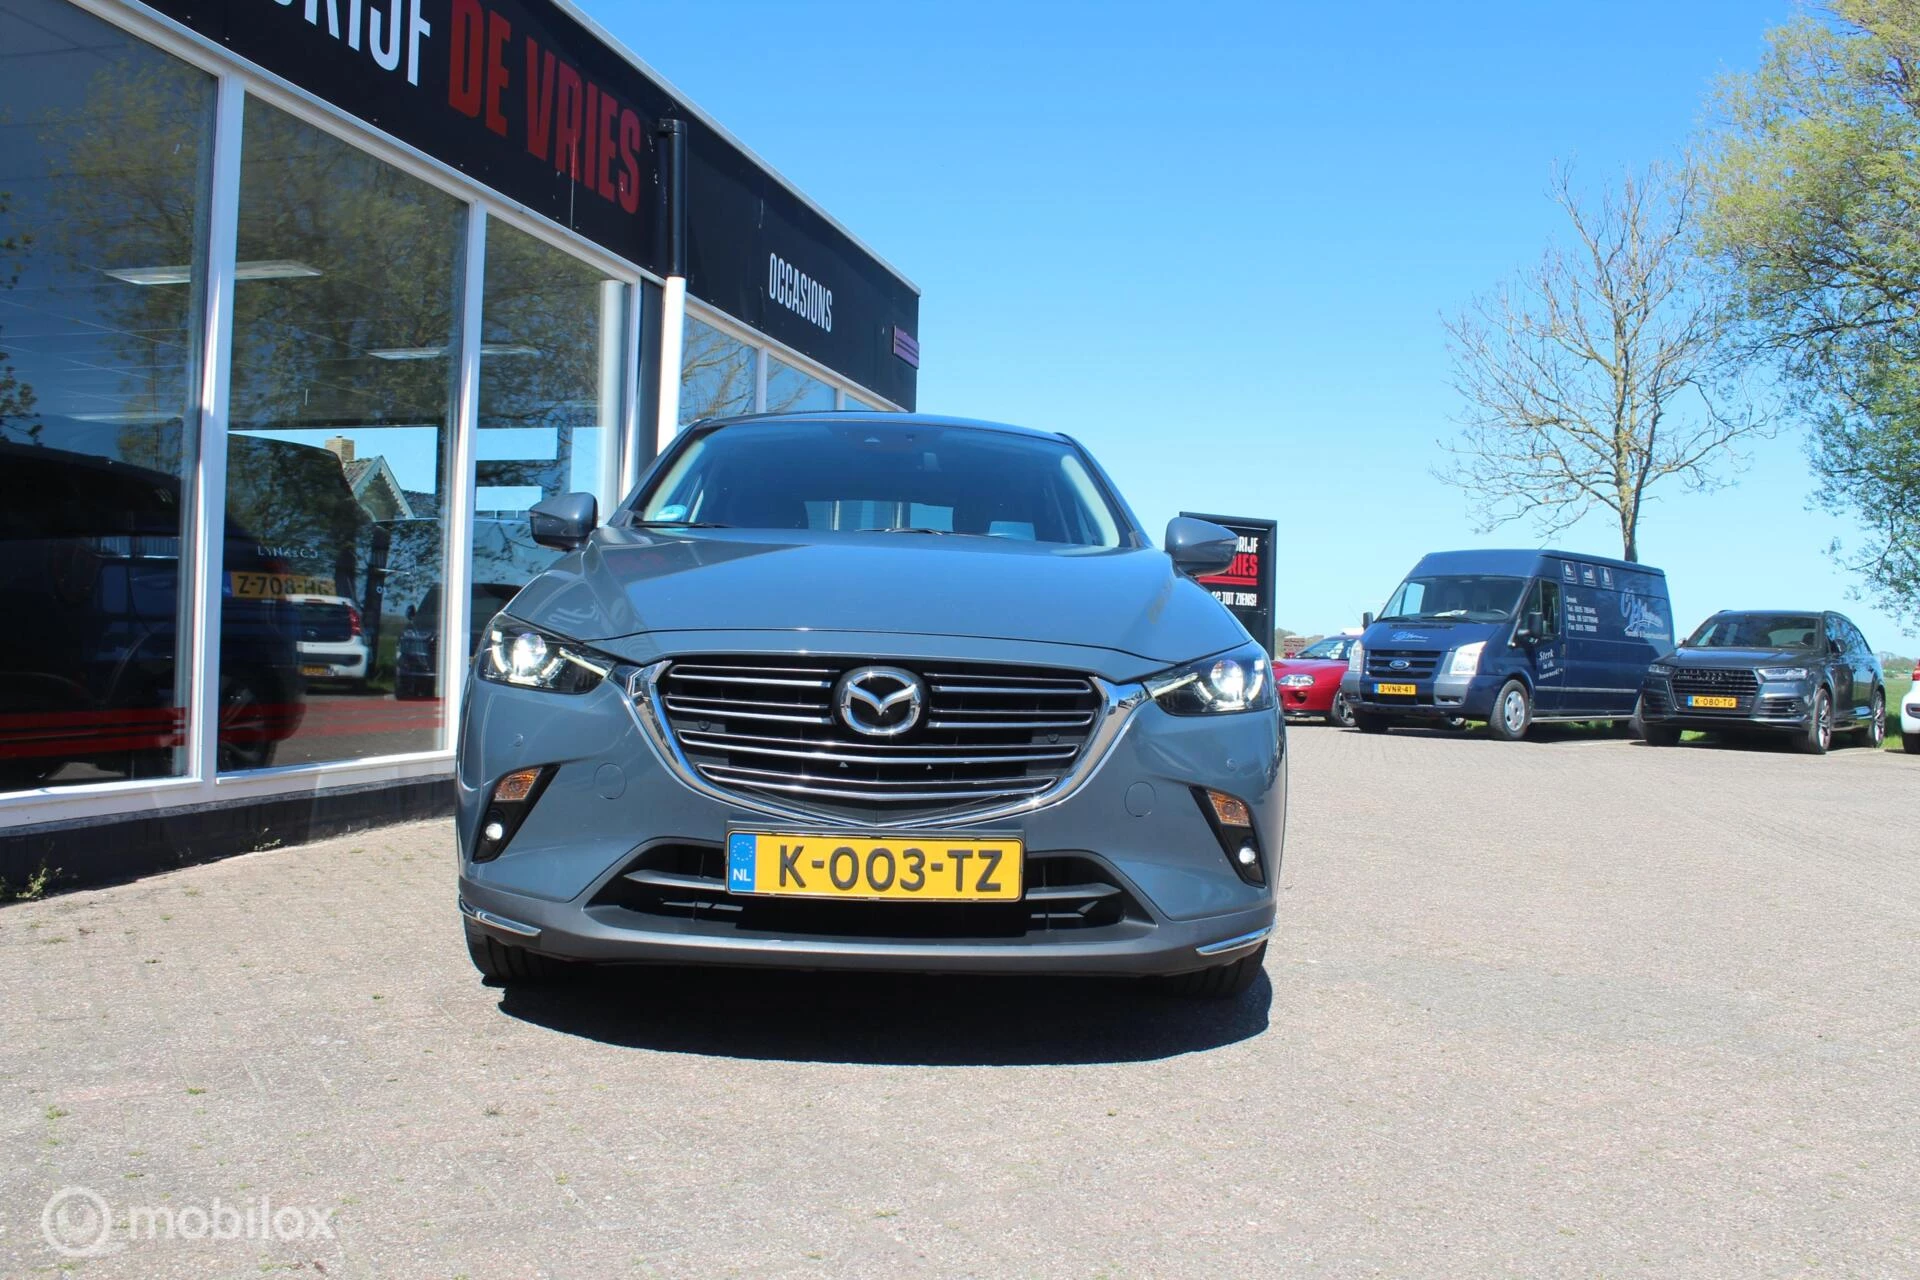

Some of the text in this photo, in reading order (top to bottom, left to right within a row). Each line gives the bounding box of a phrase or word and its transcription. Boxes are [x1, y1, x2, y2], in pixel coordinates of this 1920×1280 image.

[449, 0, 511, 137] DE
[526, 35, 641, 214] VRIES
[769, 252, 833, 333] OCCASIONS
[1236, 536, 1259, 553] RIJF
[732, 868, 751, 882] NL
[779, 844, 1003, 892] K-003-TZ
